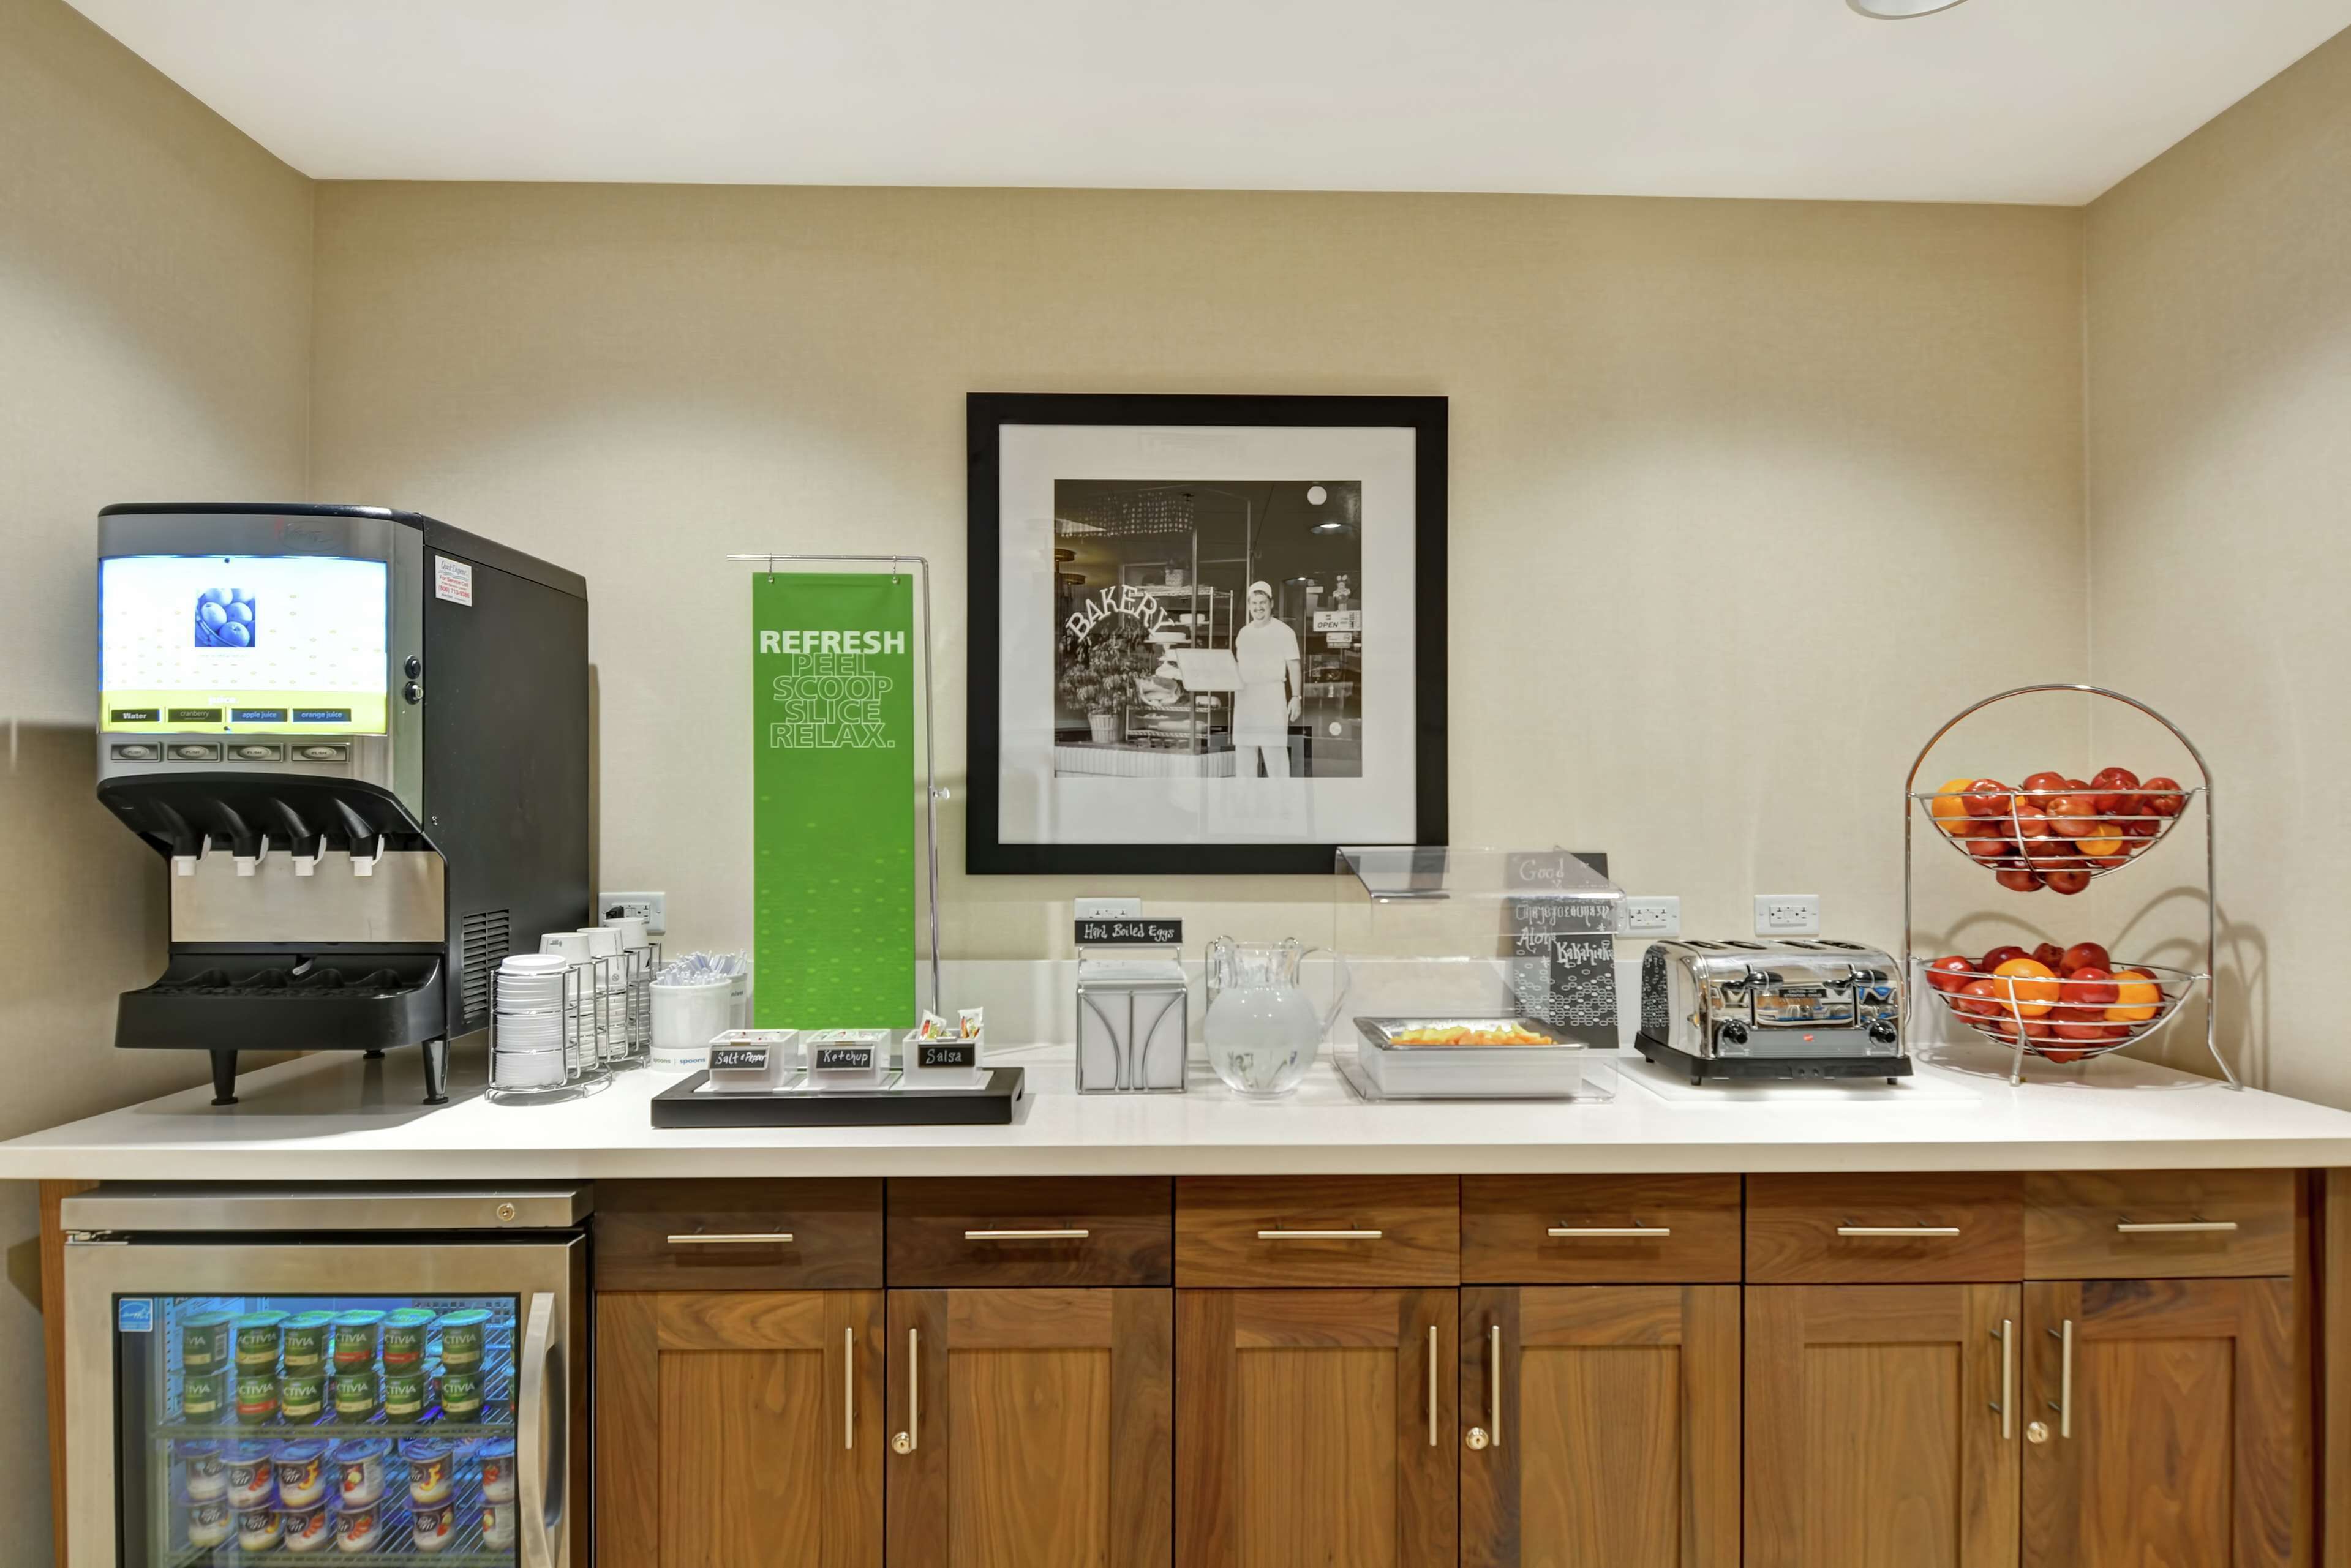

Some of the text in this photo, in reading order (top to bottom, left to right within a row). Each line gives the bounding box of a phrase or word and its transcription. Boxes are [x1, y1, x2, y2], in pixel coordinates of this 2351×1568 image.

[1066, 584, 1175, 643] BAKERY
[759, 630, 905, 655] REFRESH
[792, 653, 875, 677] PEEL
[773, 675, 893, 701] SCOOP
[785, 699, 881, 725] SLICE
[770, 723, 895, 748] RELAX.
[1519, 857, 1565, 881] Good
[1083, 923, 1175, 942] Hard Boiled Eggs
[1516, 926, 1557, 954] Aloha
[715, 1051, 739, 1065] Salt
[823, 1049, 868, 1066] Ketchup
[925, 1048, 962, 1065] Salsa
[336, 1332, 367, 1343] CTIVIA
[385, 1334, 416, 1345] CTIVIA
[443, 1334, 476, 1345] CTIVIA
[237, 1382, 274, 1395] CTIVIA
[283, 1386, 317, 1397] CTIVIA
[336, 1382, 369, 1394] CTIVIA
[386, 1384, 417, 1395] CTIVIA
[443, 1382, 476, 1394] CTIVIA
